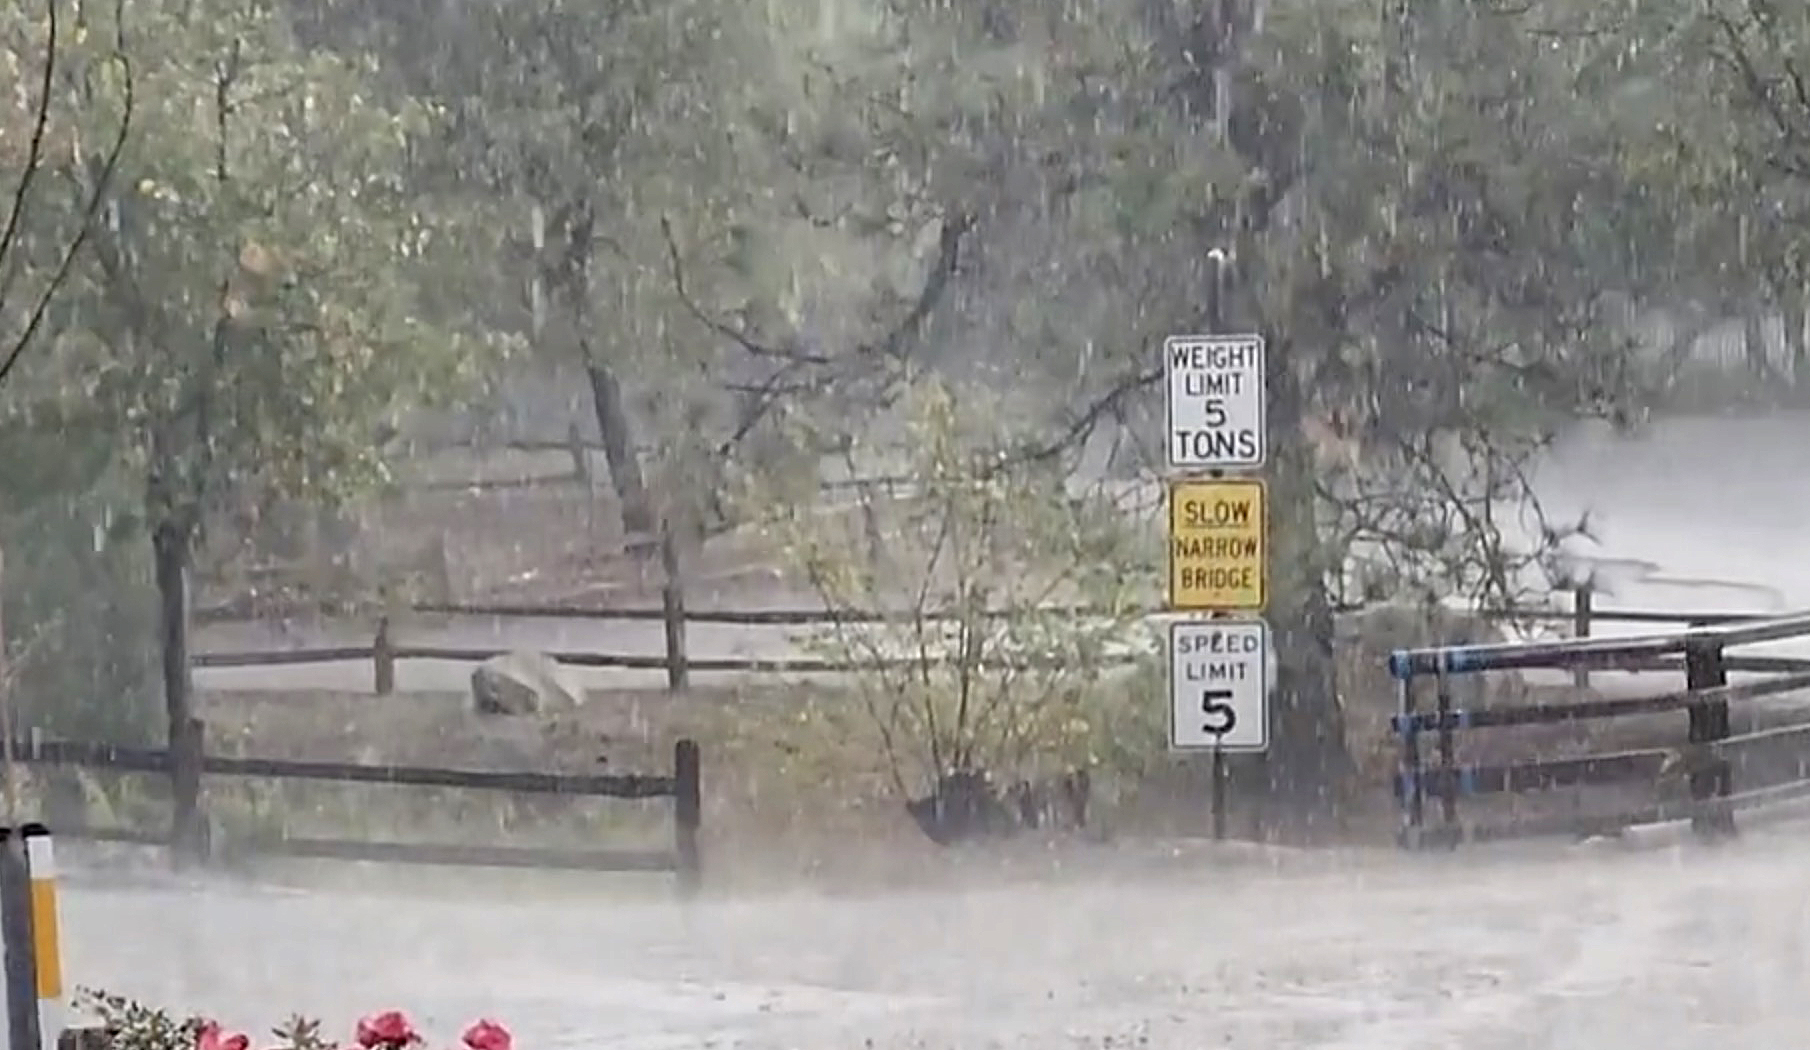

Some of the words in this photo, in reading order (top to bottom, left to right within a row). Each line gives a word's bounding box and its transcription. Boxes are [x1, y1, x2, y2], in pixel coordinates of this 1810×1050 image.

[1170, 346, 1255, 369] WEIGHT
[1185, 373, 1242, 396] LIMIT
[1205, 400, 1226, 428] 5
[1176, 430, 1256, 459] TONS
[1184, 500, 1251, 524] SLOW
[1176, 537, 1257, 559] NARROW
[1181, 567, 1252, 590] BRIDGE
[1178, 633, 1258, 653] SPEED
[1187, 662, 1245, 681] LIMIT
[1203, 690, 1236, 734] 5
